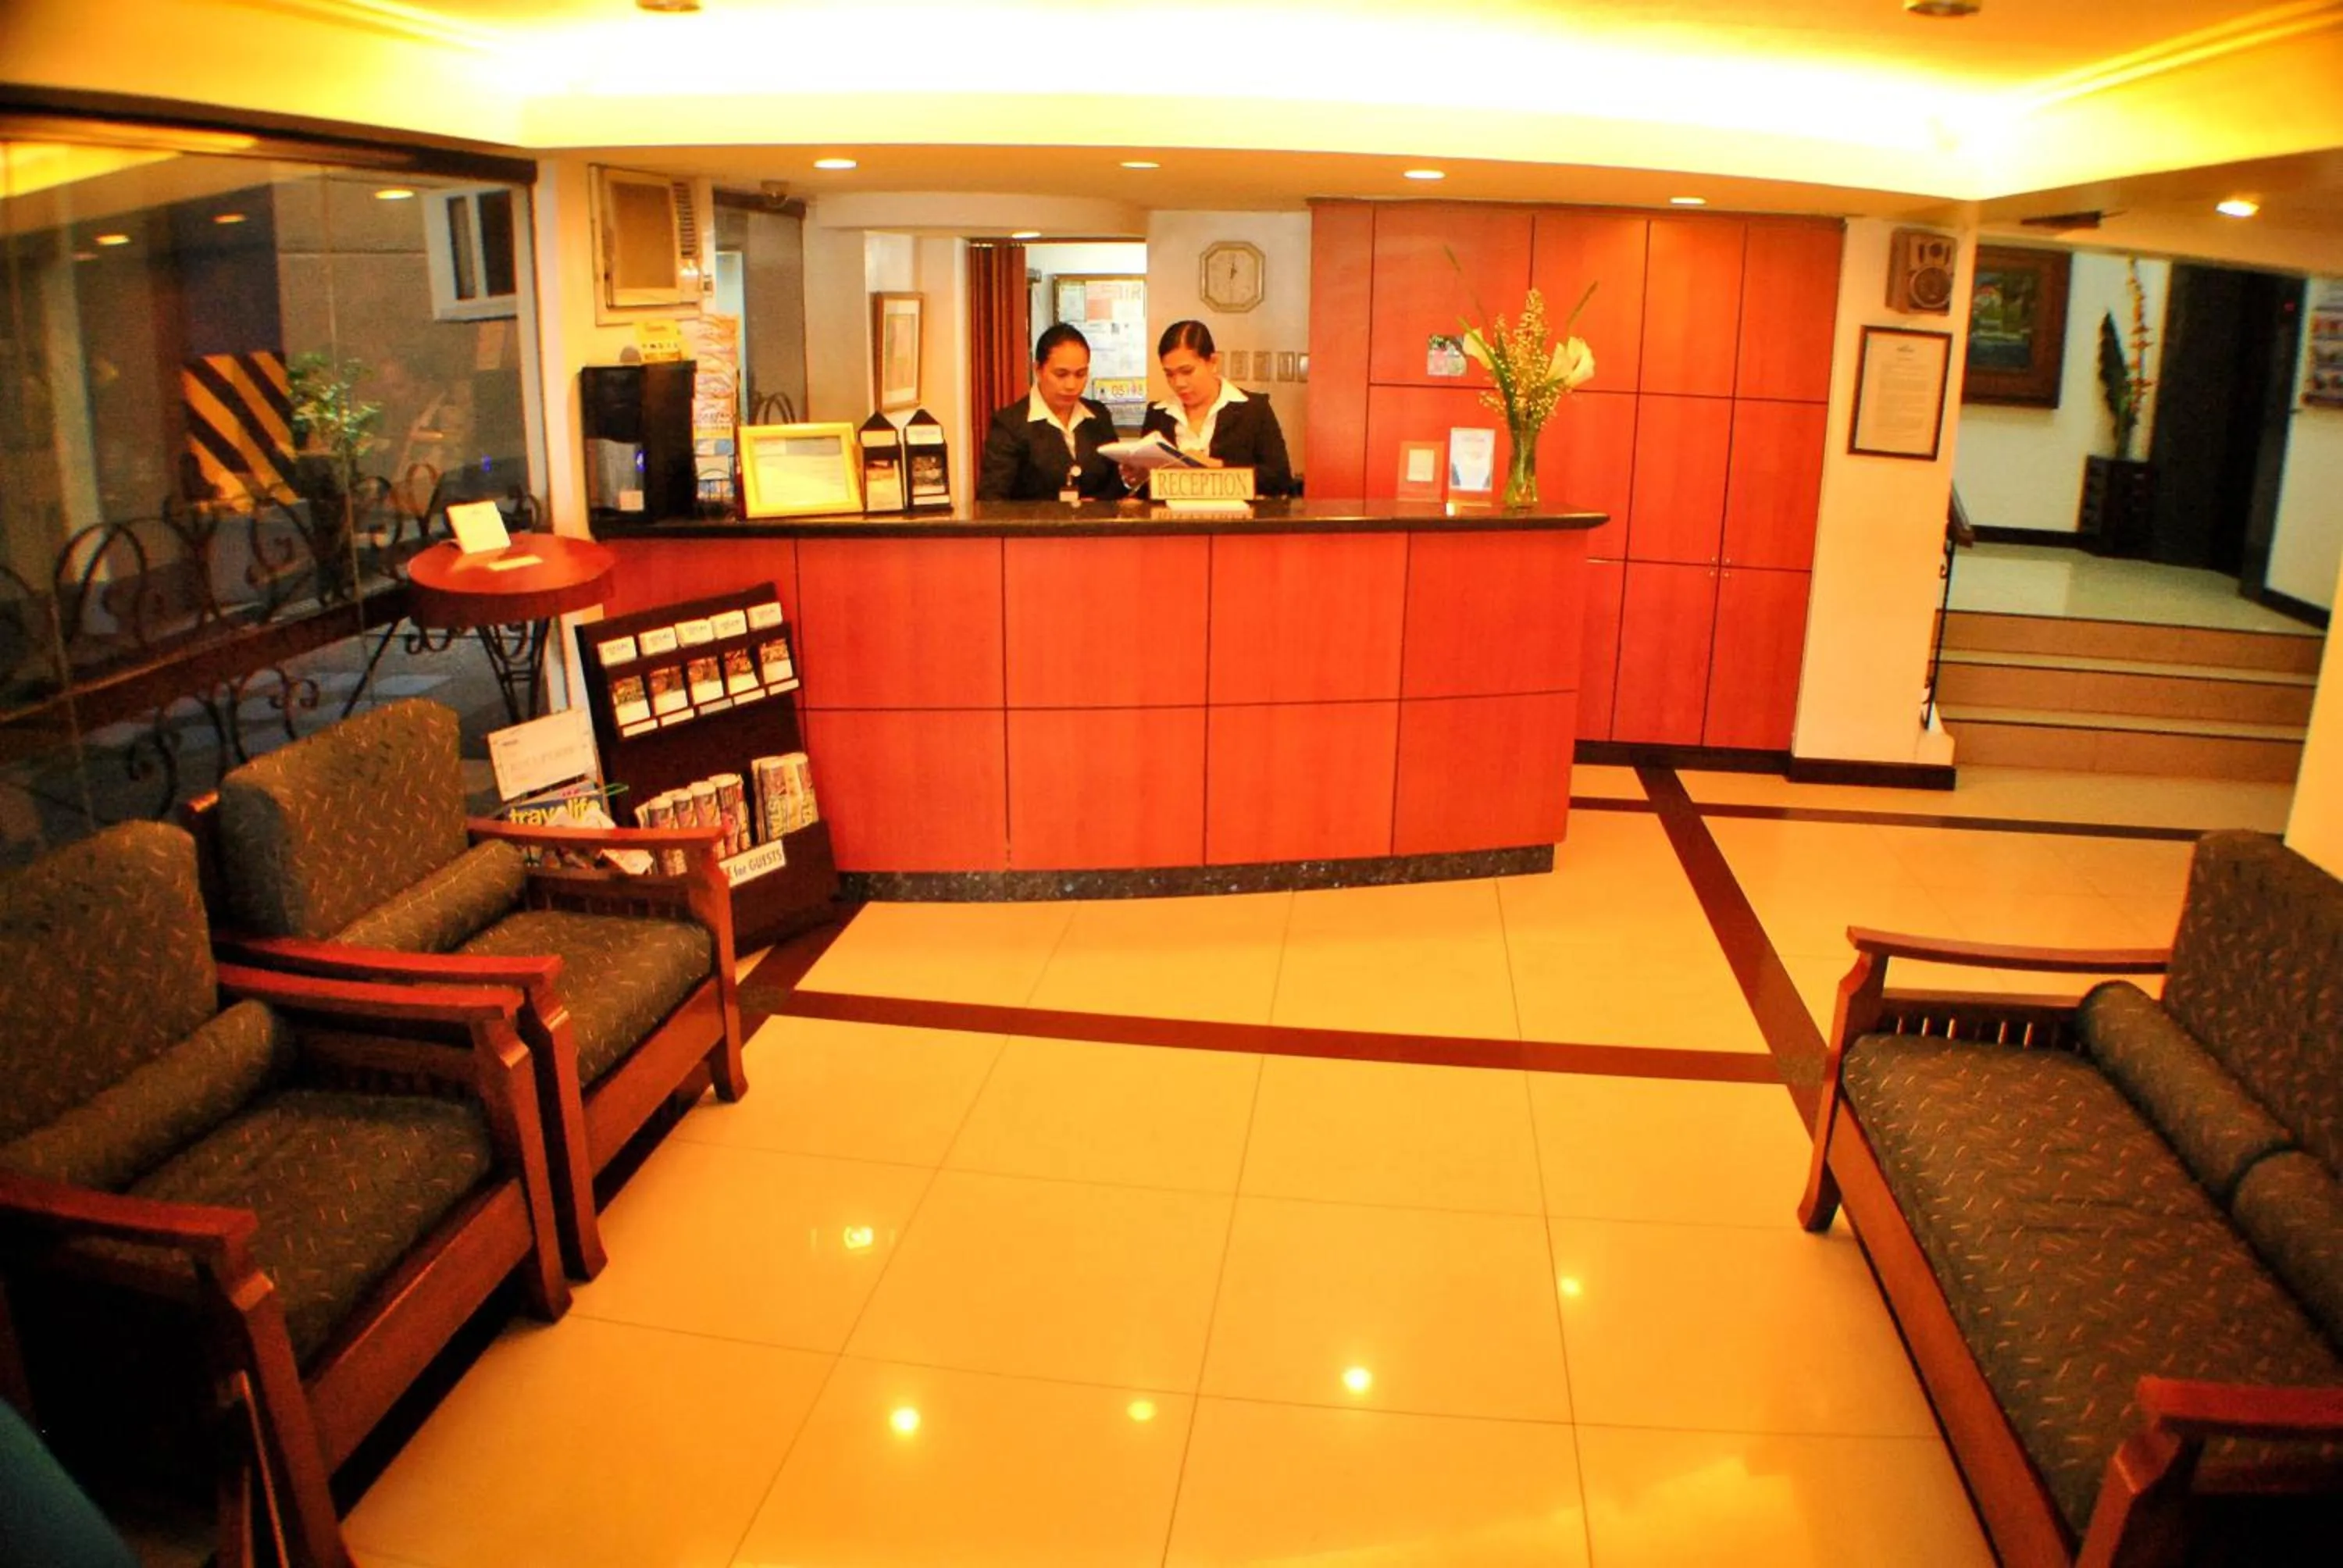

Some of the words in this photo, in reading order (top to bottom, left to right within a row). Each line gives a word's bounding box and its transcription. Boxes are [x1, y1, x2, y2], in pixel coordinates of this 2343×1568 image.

[1157, 472, 1248, 497] RECEPTION
[509, 797, 601, 825] travlife
[748, 848, 783, 871] GUESTS
